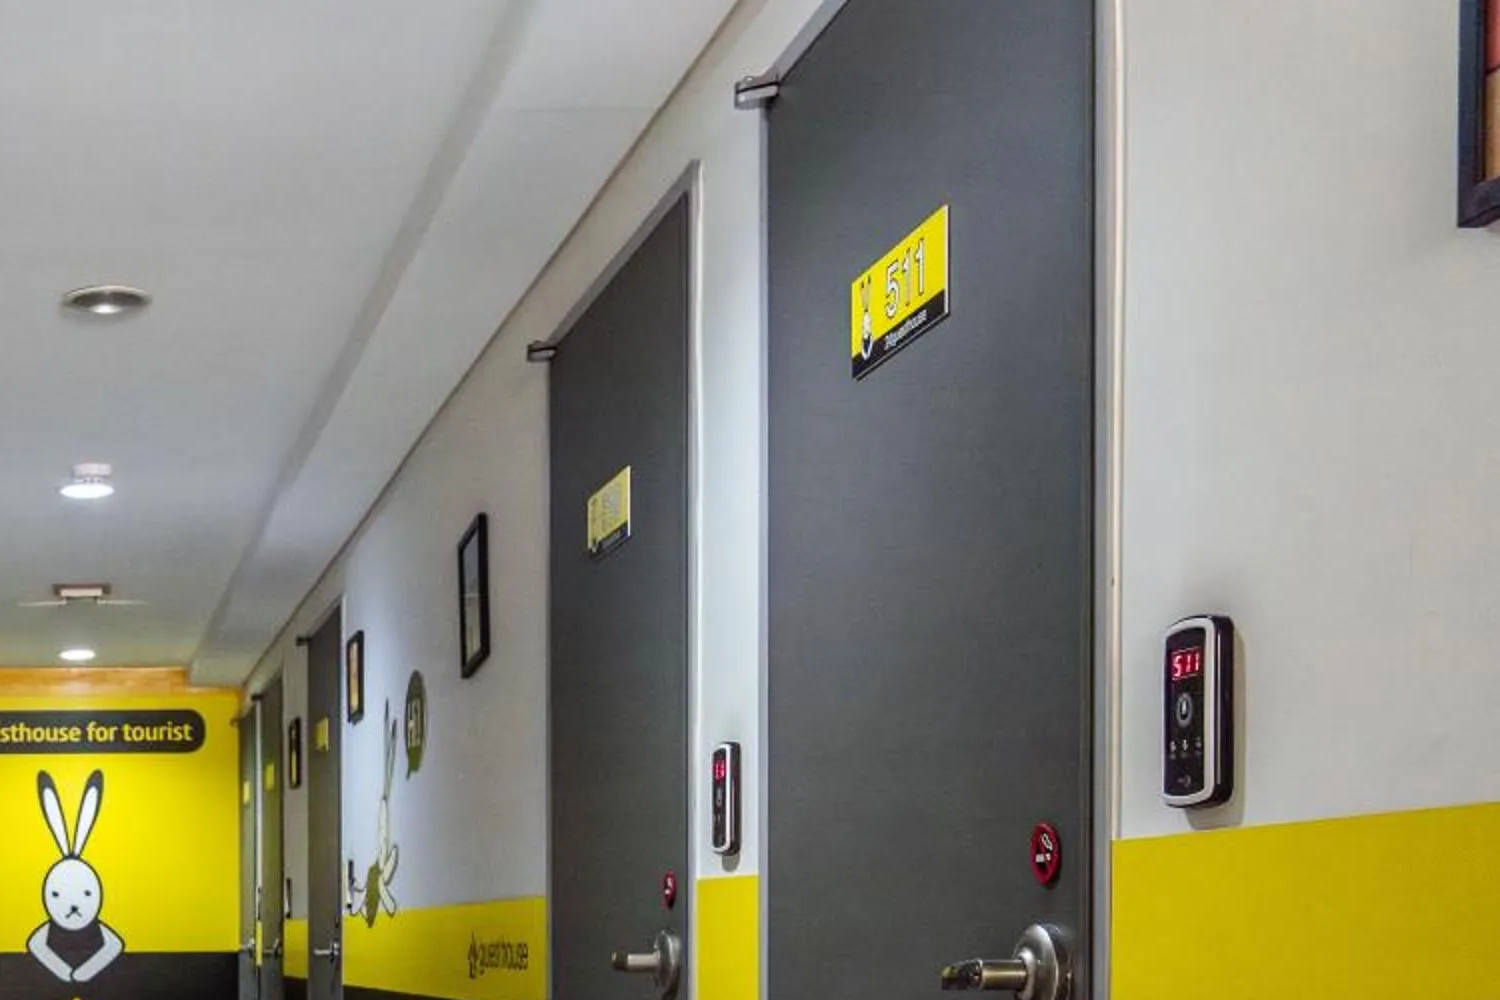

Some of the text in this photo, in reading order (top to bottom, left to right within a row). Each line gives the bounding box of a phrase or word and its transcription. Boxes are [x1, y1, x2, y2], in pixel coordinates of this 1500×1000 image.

[884, 237, 925, 320] 511
[1172, 653, 1200, 678] 511
[86, 721, 117, 742] for
[122, 721, 194, 742] tourist
